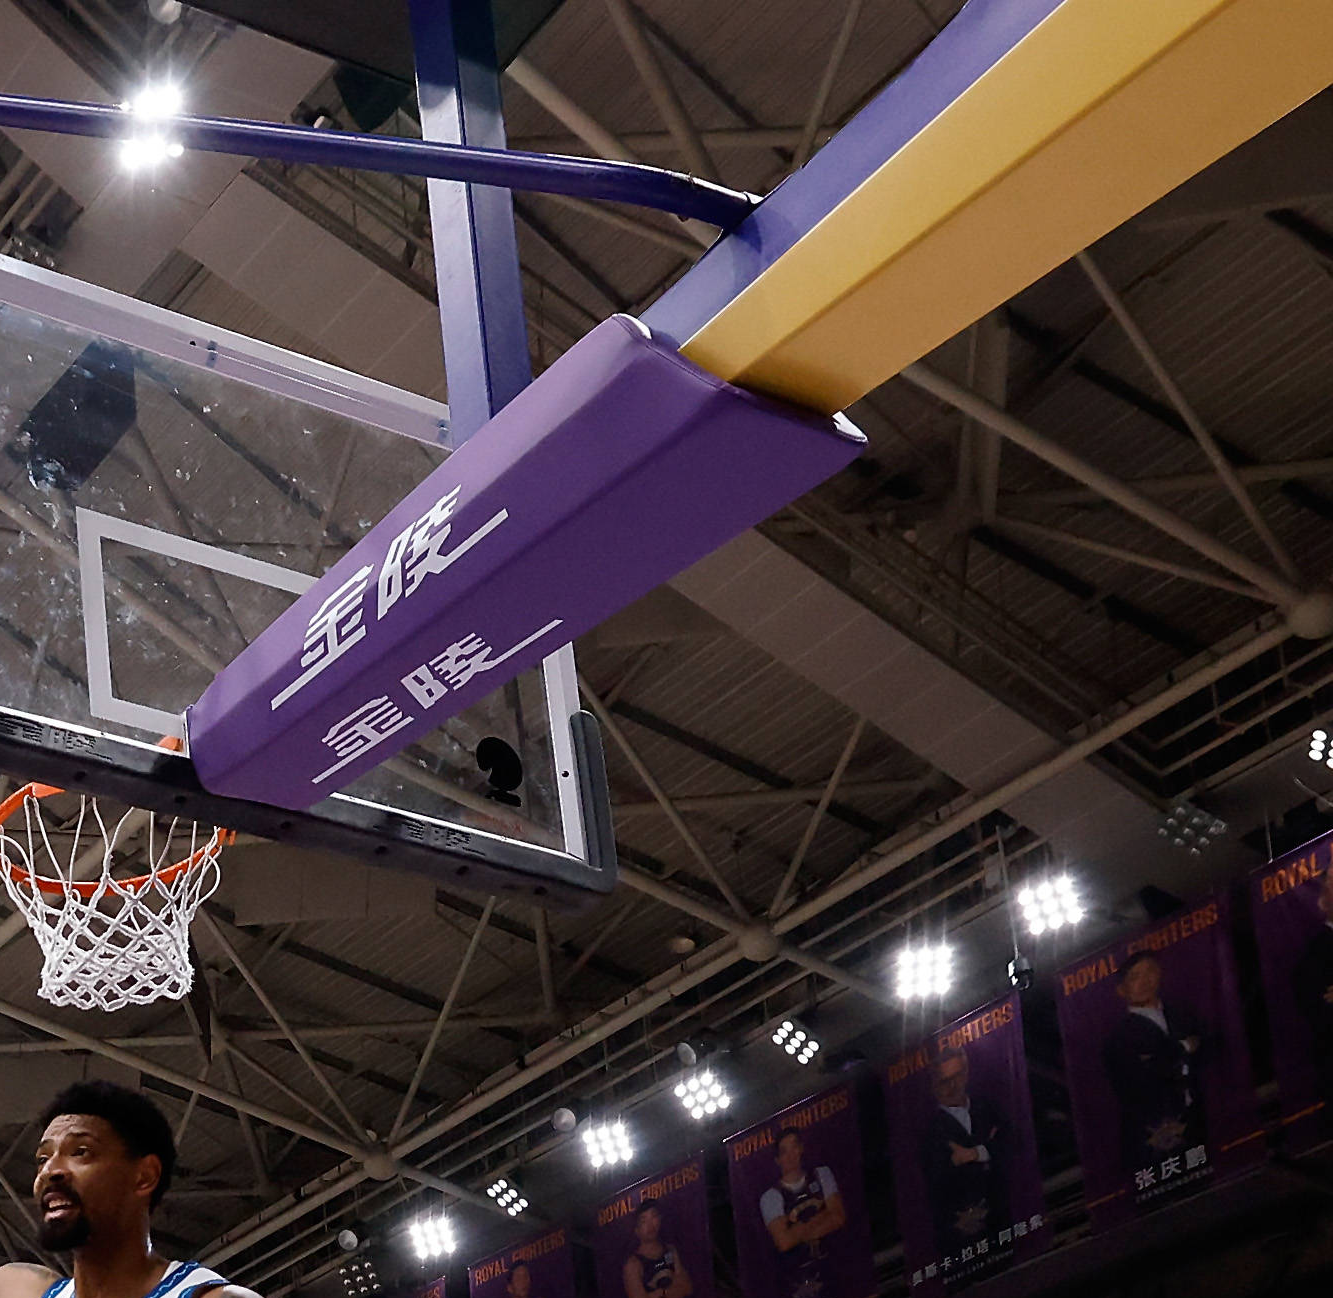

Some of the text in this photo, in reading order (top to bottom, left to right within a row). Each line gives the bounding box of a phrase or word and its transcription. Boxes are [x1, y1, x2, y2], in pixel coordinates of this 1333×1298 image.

[270, 484, 508, 710] 金陵
[312, 619, 563, 784] 金陵
[1261, 852, 1324, 904] ROYAL
[1063, 955, 1119, 996] ROYAL
[938, 1001, 1014, 1053] FIGHTERS
